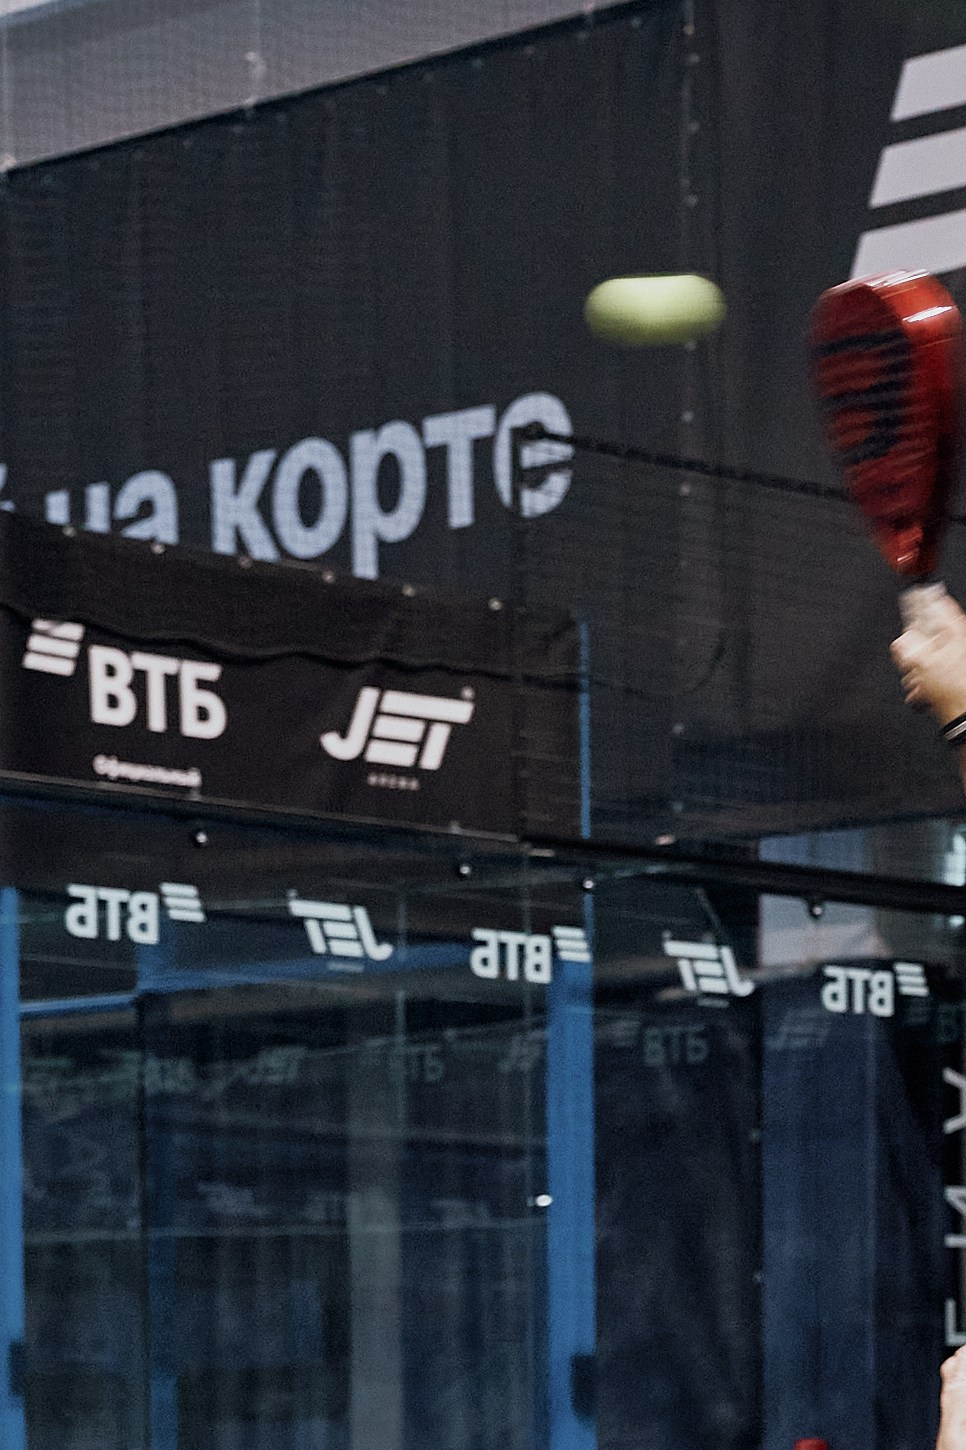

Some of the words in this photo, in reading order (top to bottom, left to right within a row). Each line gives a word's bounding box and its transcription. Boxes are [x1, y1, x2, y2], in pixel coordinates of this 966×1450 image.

[208, 391, 575, 581] корте
[88, 644, 228, 740] ВТБ
[319, 685, 475, 771] JET
